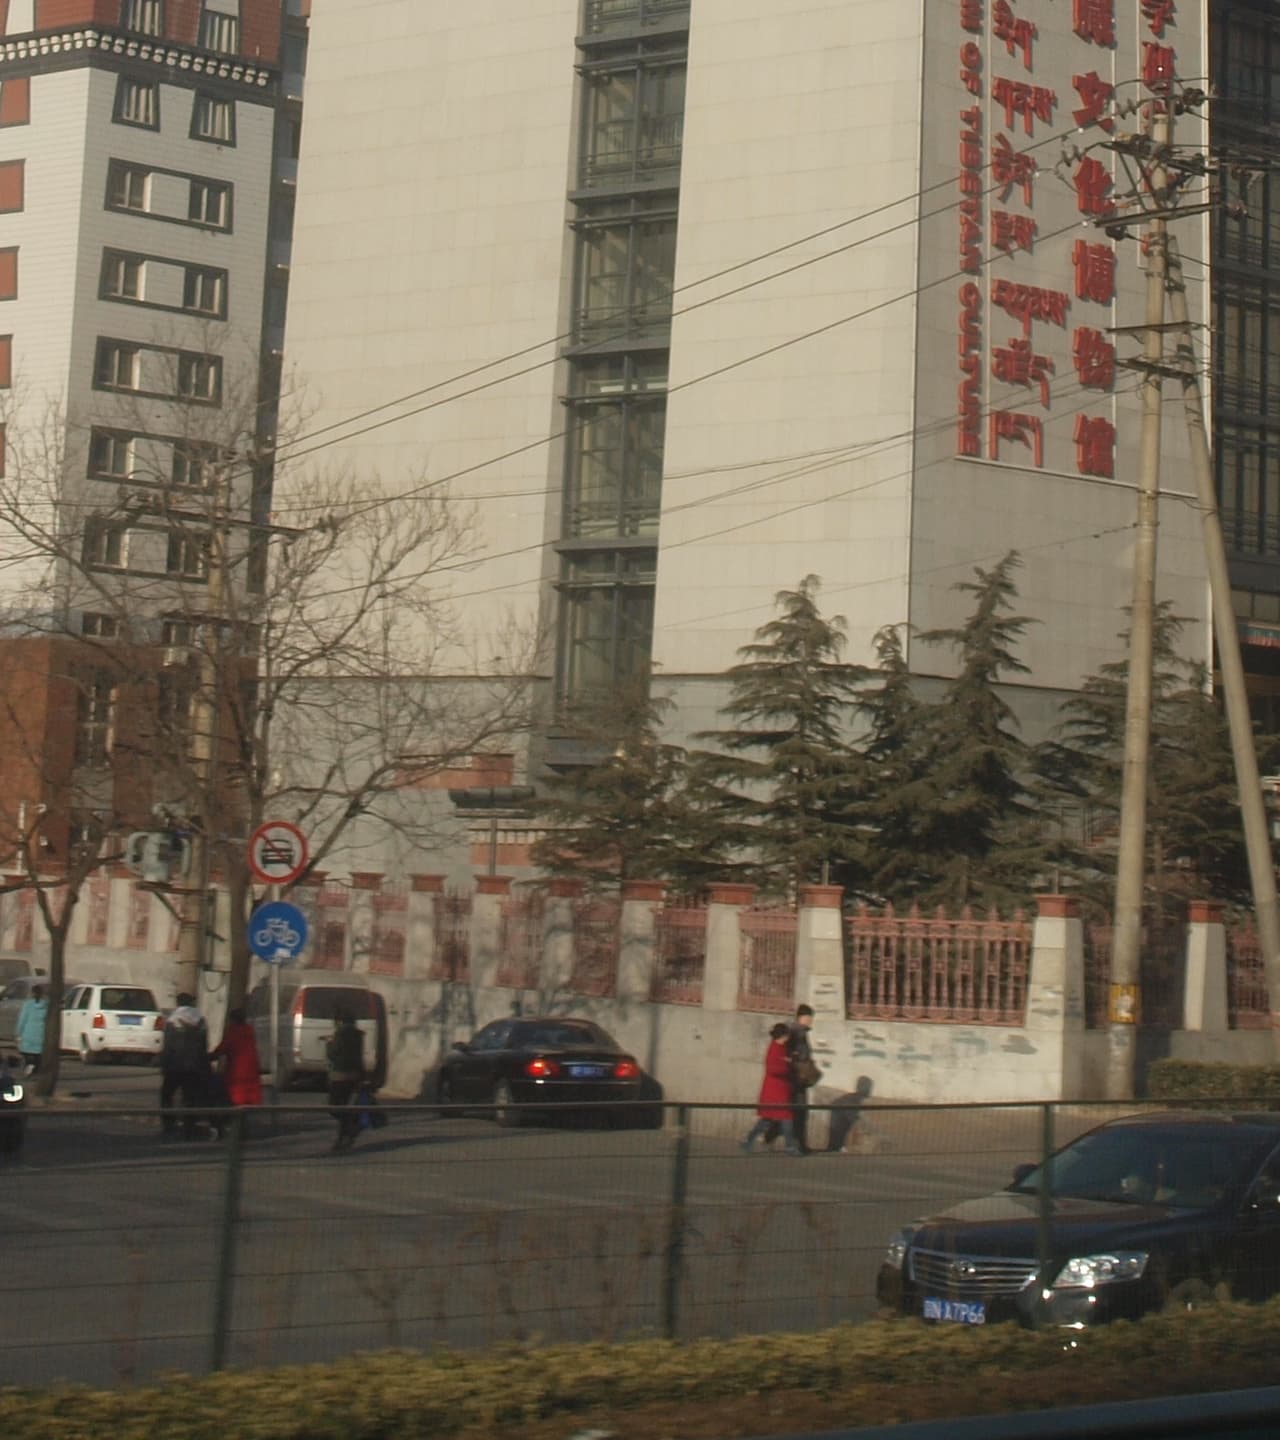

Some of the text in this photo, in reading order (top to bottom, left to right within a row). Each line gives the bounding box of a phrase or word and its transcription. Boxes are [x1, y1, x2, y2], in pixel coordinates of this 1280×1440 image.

[959, 41, 981, 92] OF
[957, 103, 981, 271] TIBETAN
[956, 282, 980, 456] CULTURE
